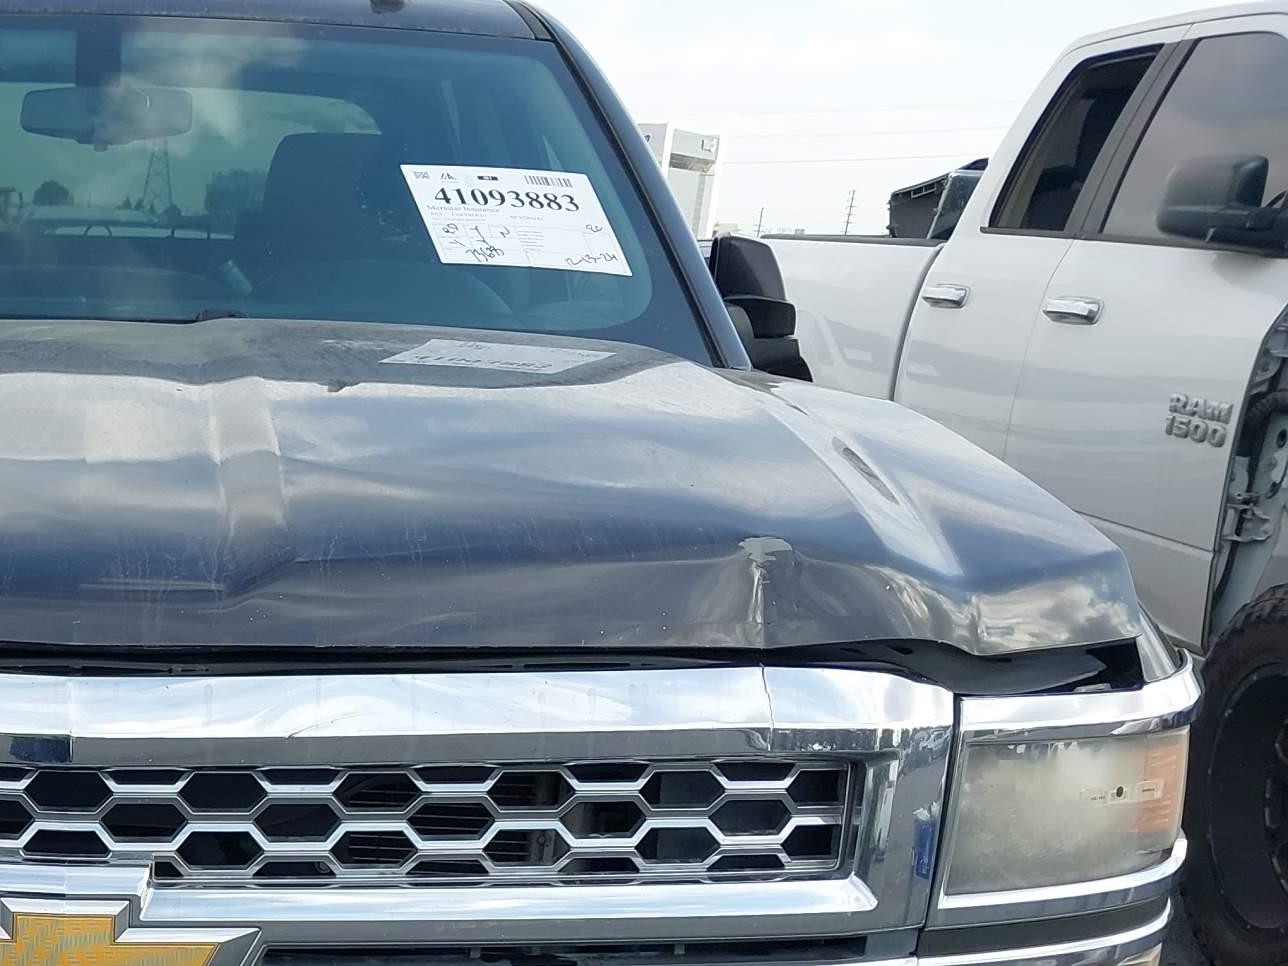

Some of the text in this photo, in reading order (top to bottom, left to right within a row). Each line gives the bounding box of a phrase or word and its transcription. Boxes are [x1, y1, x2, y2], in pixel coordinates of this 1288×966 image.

[434, 187, 580, 212] 41093883
[1169, 394, 1233, 424] RAM
[1165, 416, 1227, 447] 1500
